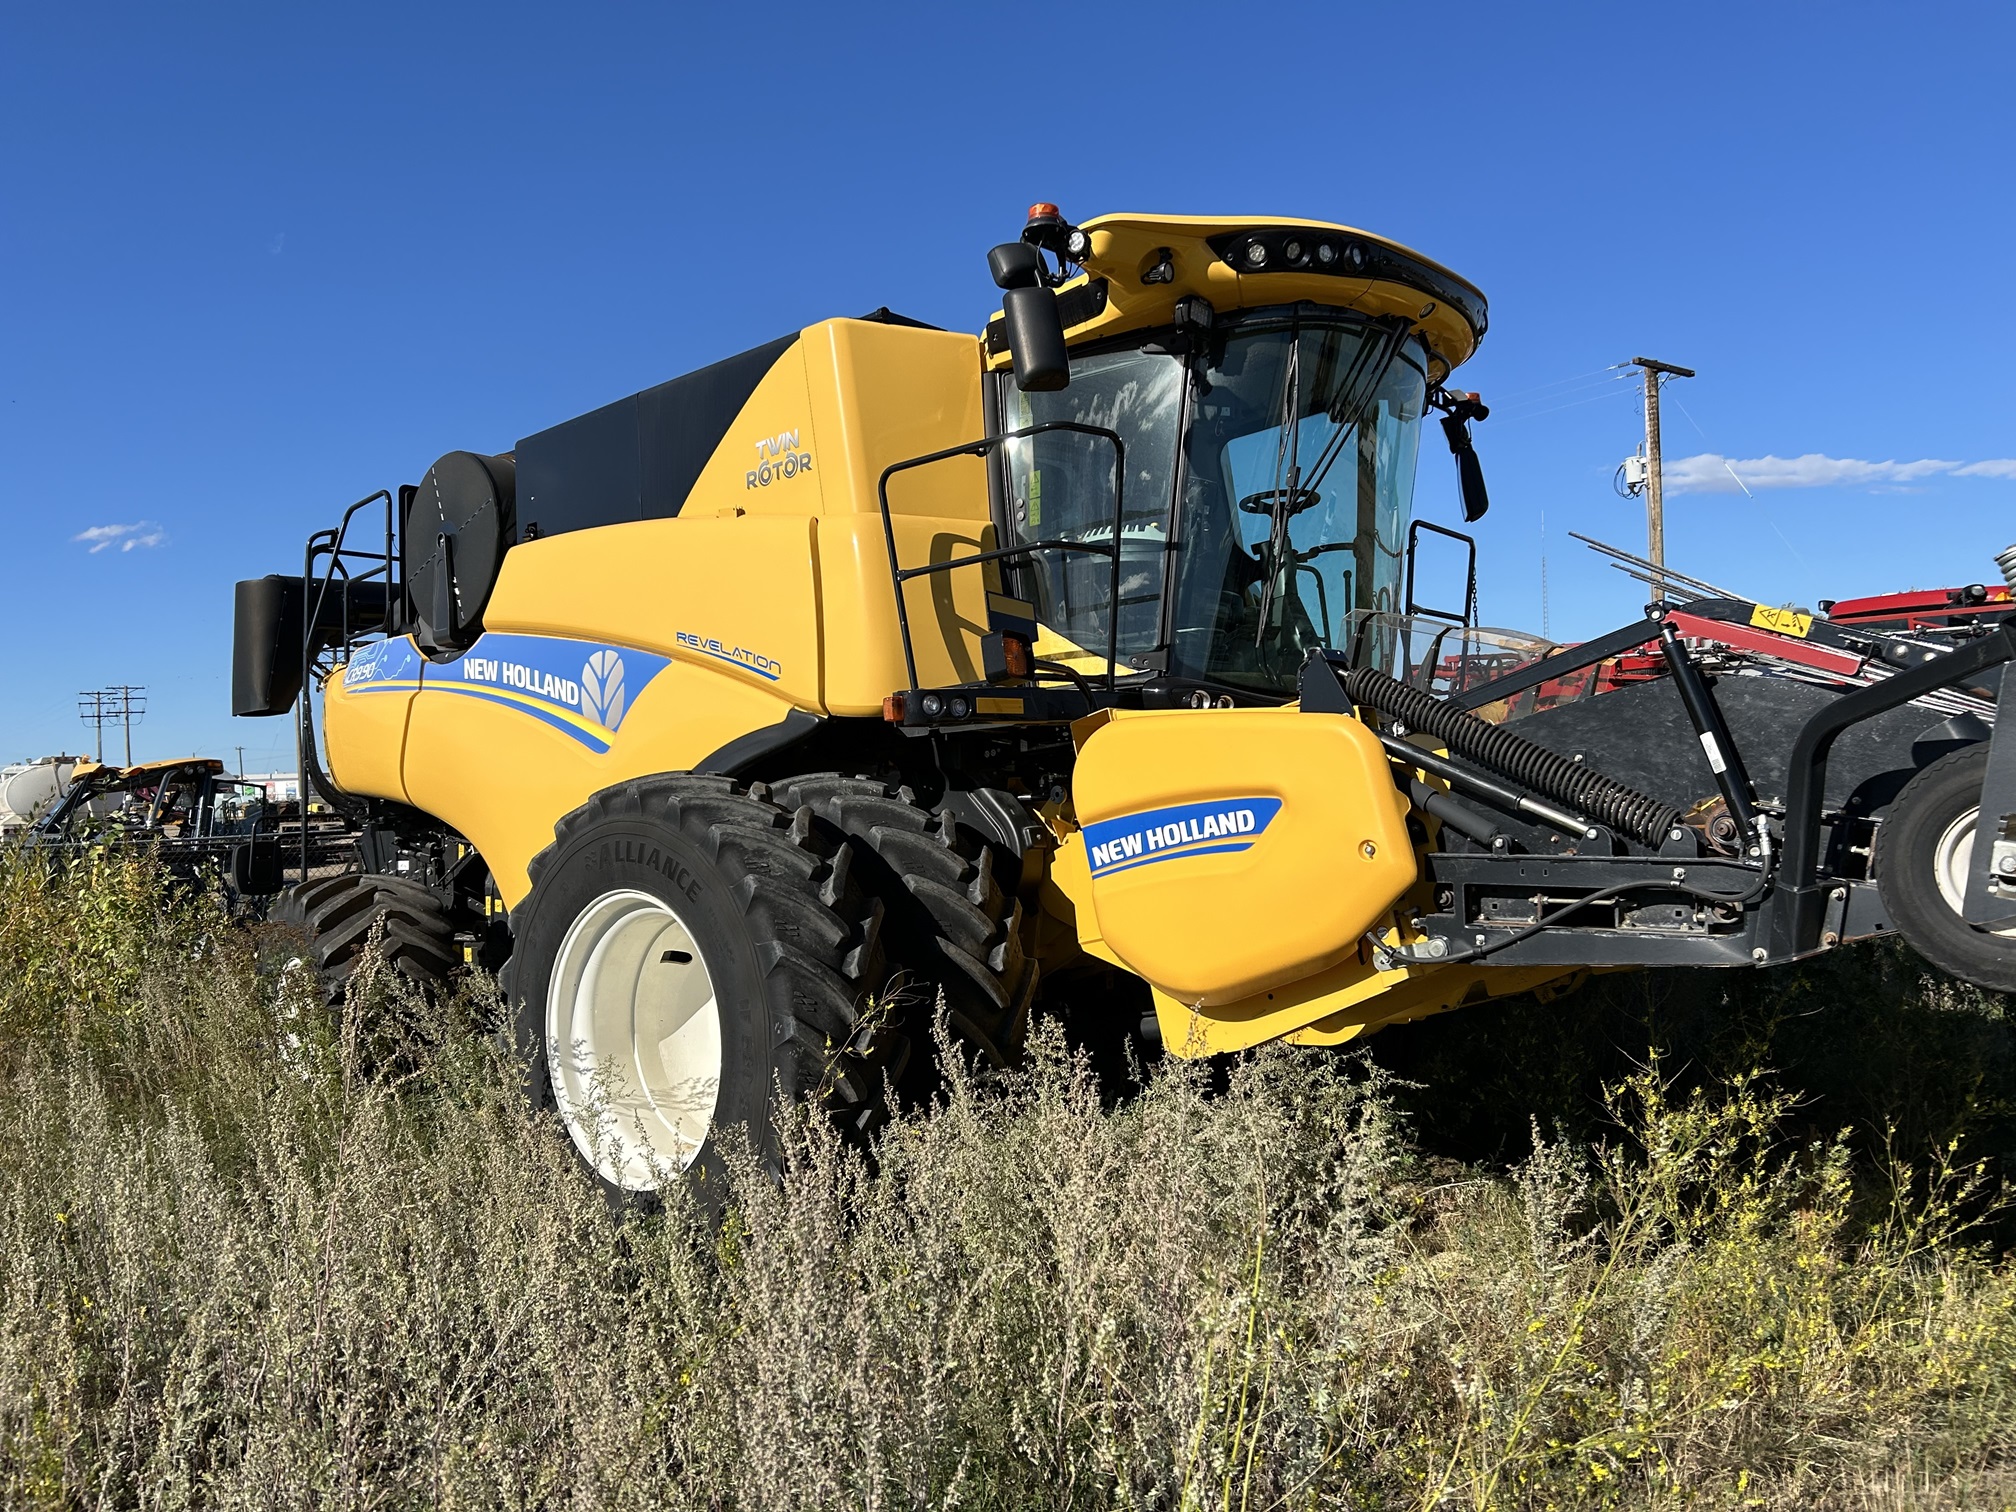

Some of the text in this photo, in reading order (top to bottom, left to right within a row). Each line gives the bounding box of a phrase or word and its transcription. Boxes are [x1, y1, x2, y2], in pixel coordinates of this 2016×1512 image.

[755, 428, 800, 460] TWIN
[746, 452, 812, 490] ROTOR
[463, 658, 580, 706] NEW HOLLAND
[1091, 808, 1256, 868] NEW HOLLAND
[598, 839, 704, 904] ALLIANCE
